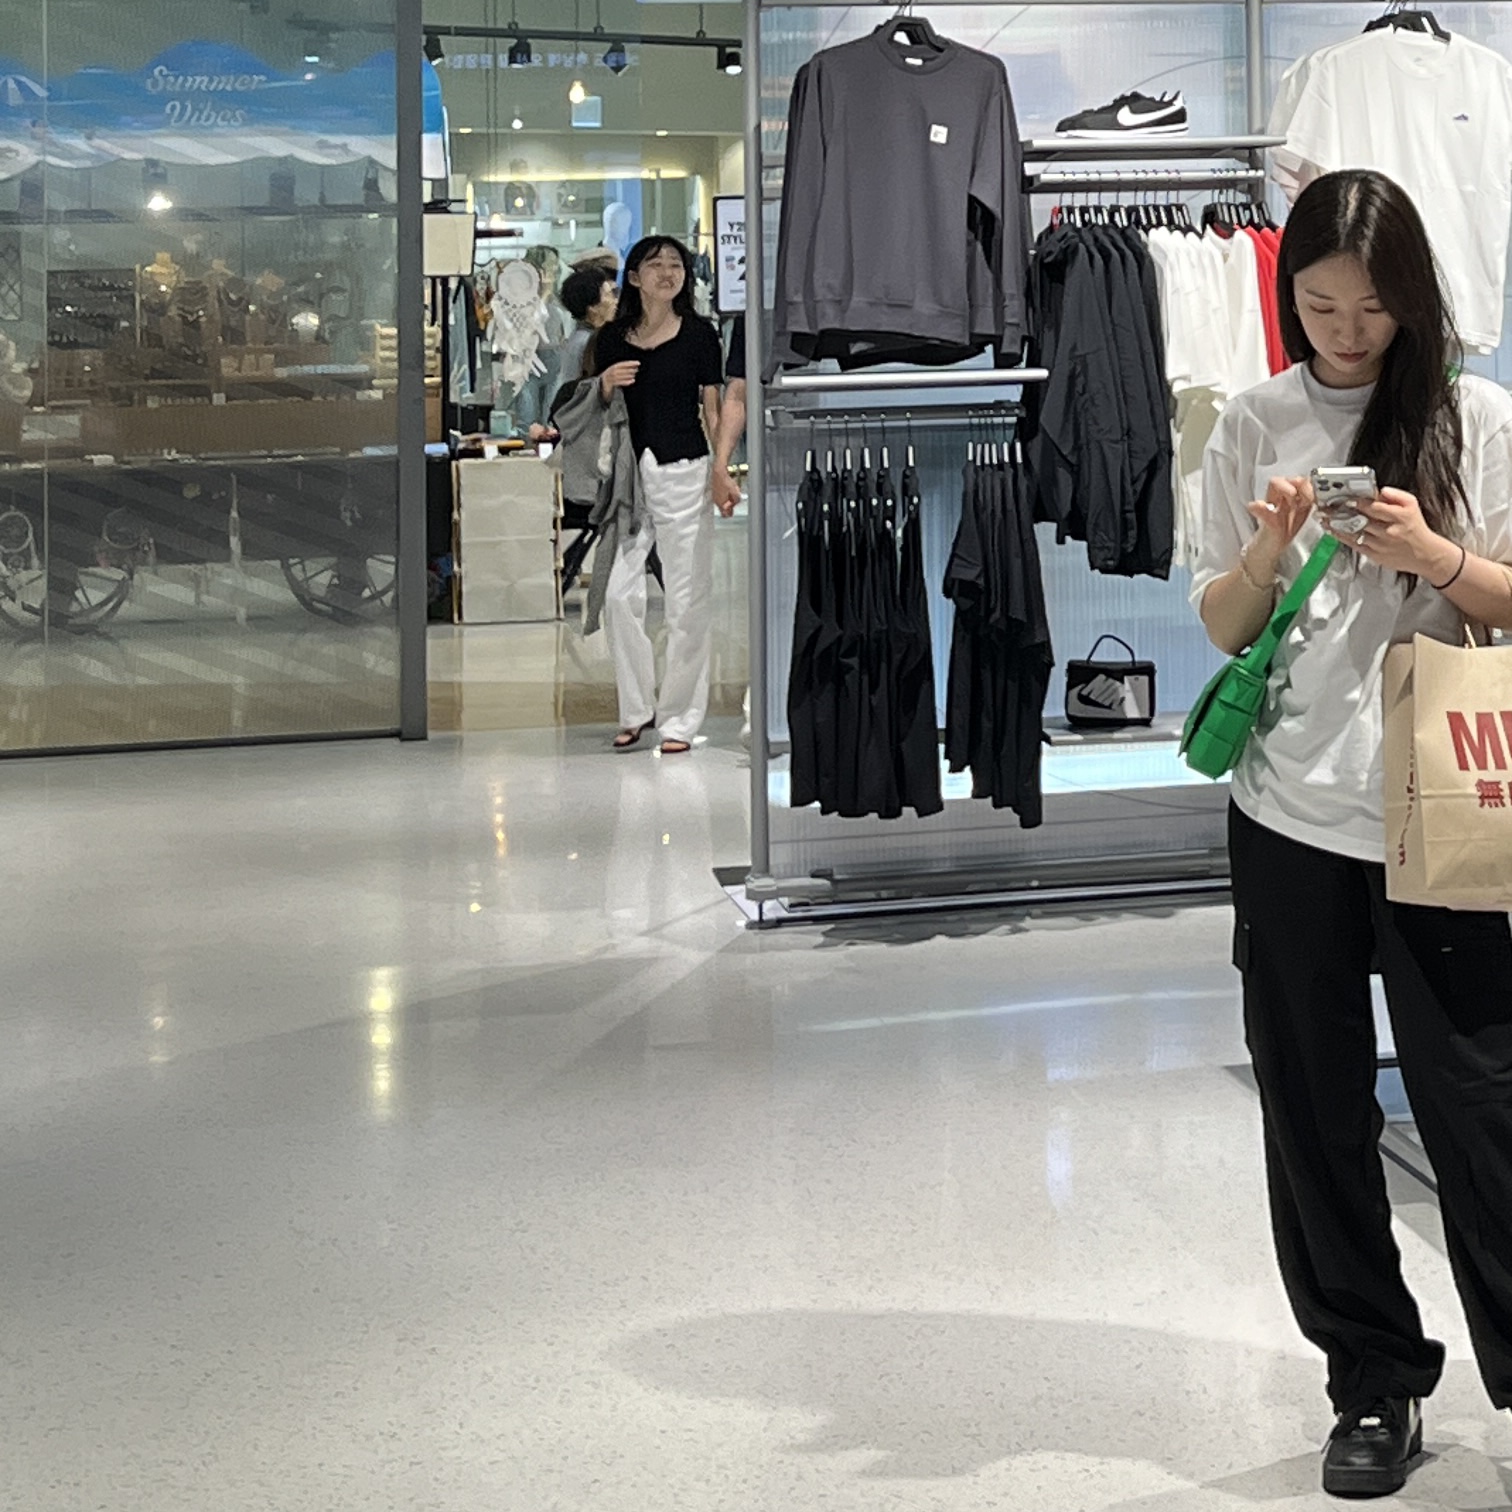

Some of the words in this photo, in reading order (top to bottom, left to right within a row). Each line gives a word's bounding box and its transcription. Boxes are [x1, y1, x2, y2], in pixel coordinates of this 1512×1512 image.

[146, 65, 267, 94] Summer
[165, 100, 246, 126] Vibes
[720, 233, 745, 245] STYL
